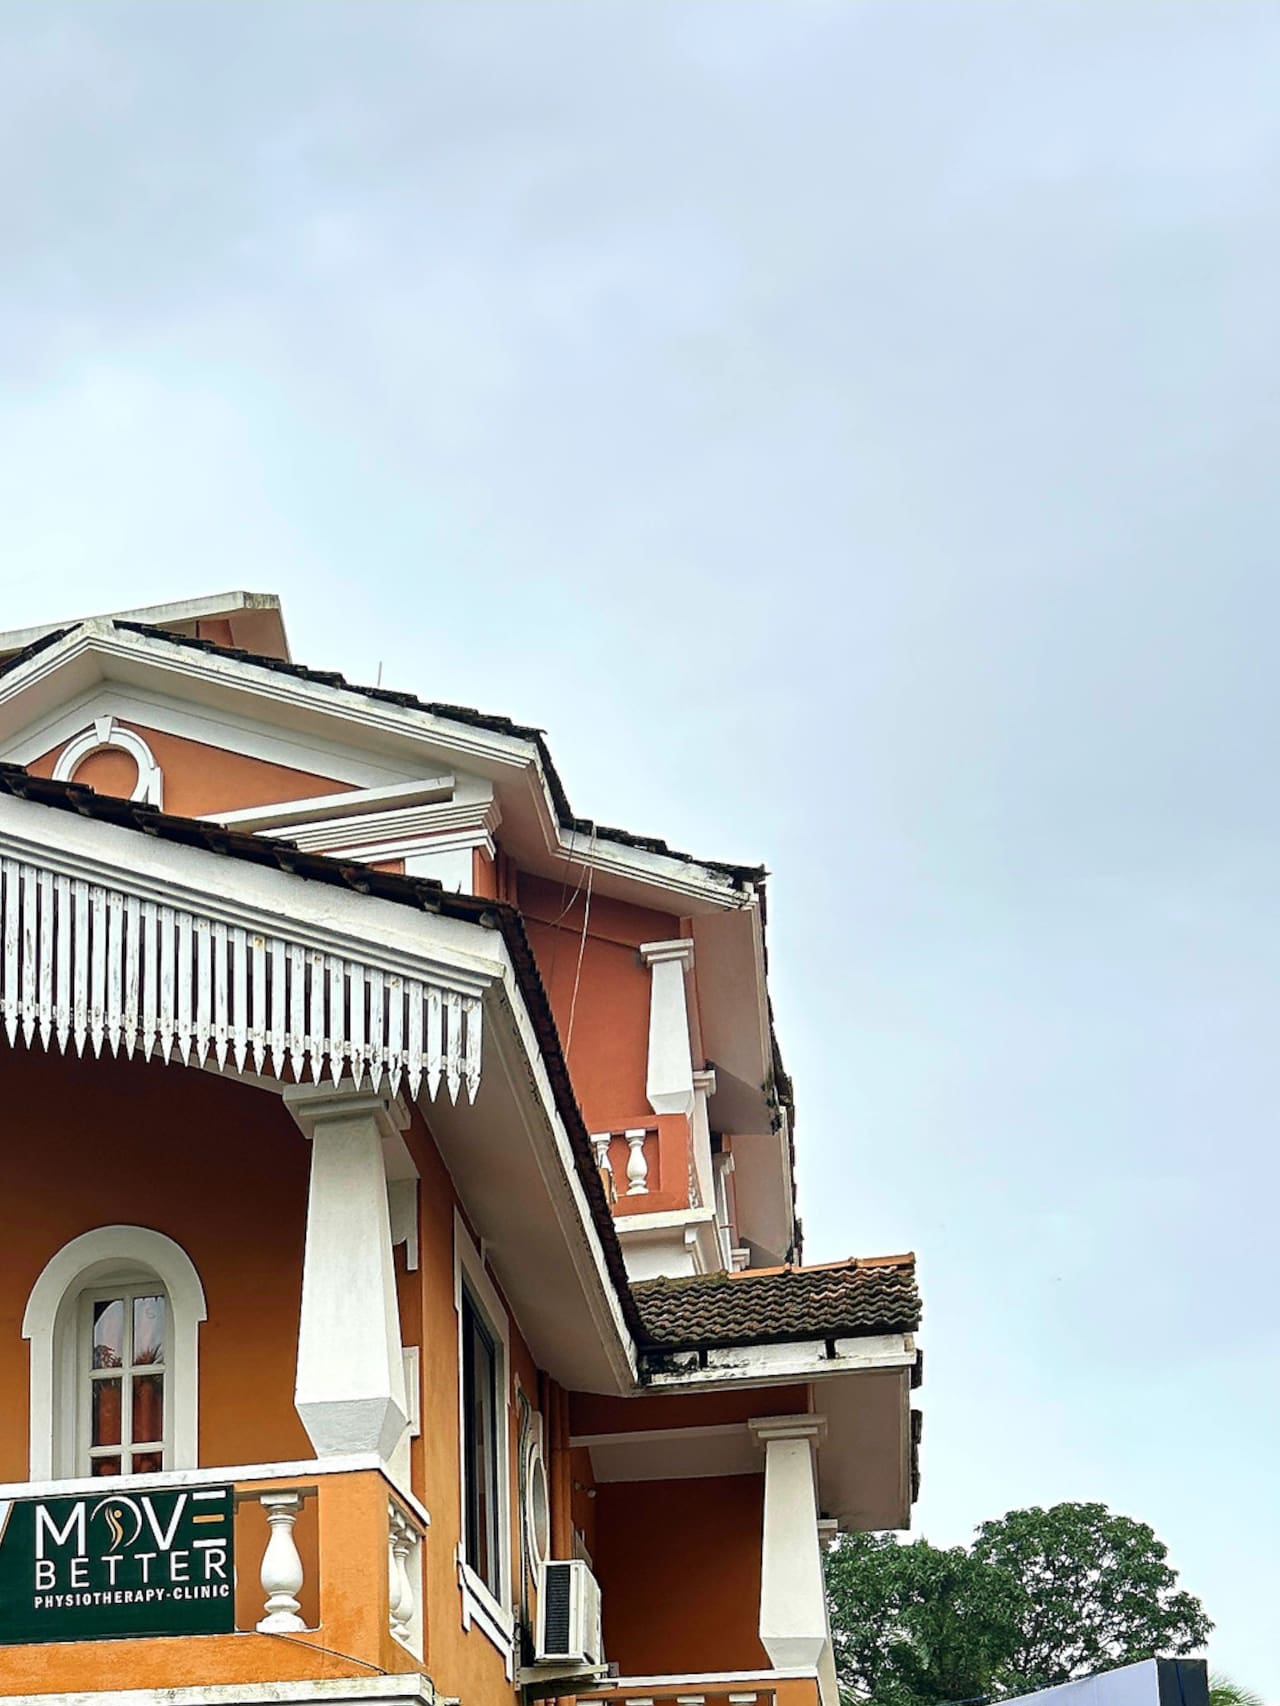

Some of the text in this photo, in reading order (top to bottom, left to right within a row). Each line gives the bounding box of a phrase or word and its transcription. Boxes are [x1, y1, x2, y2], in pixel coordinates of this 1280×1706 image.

[35, 1490, 227, 1559] MOVE
[35, 1549, 227, 1591] BETTER
[34, 1584, 230, 1609] PHYSIOTHERAPY-CLINIC
